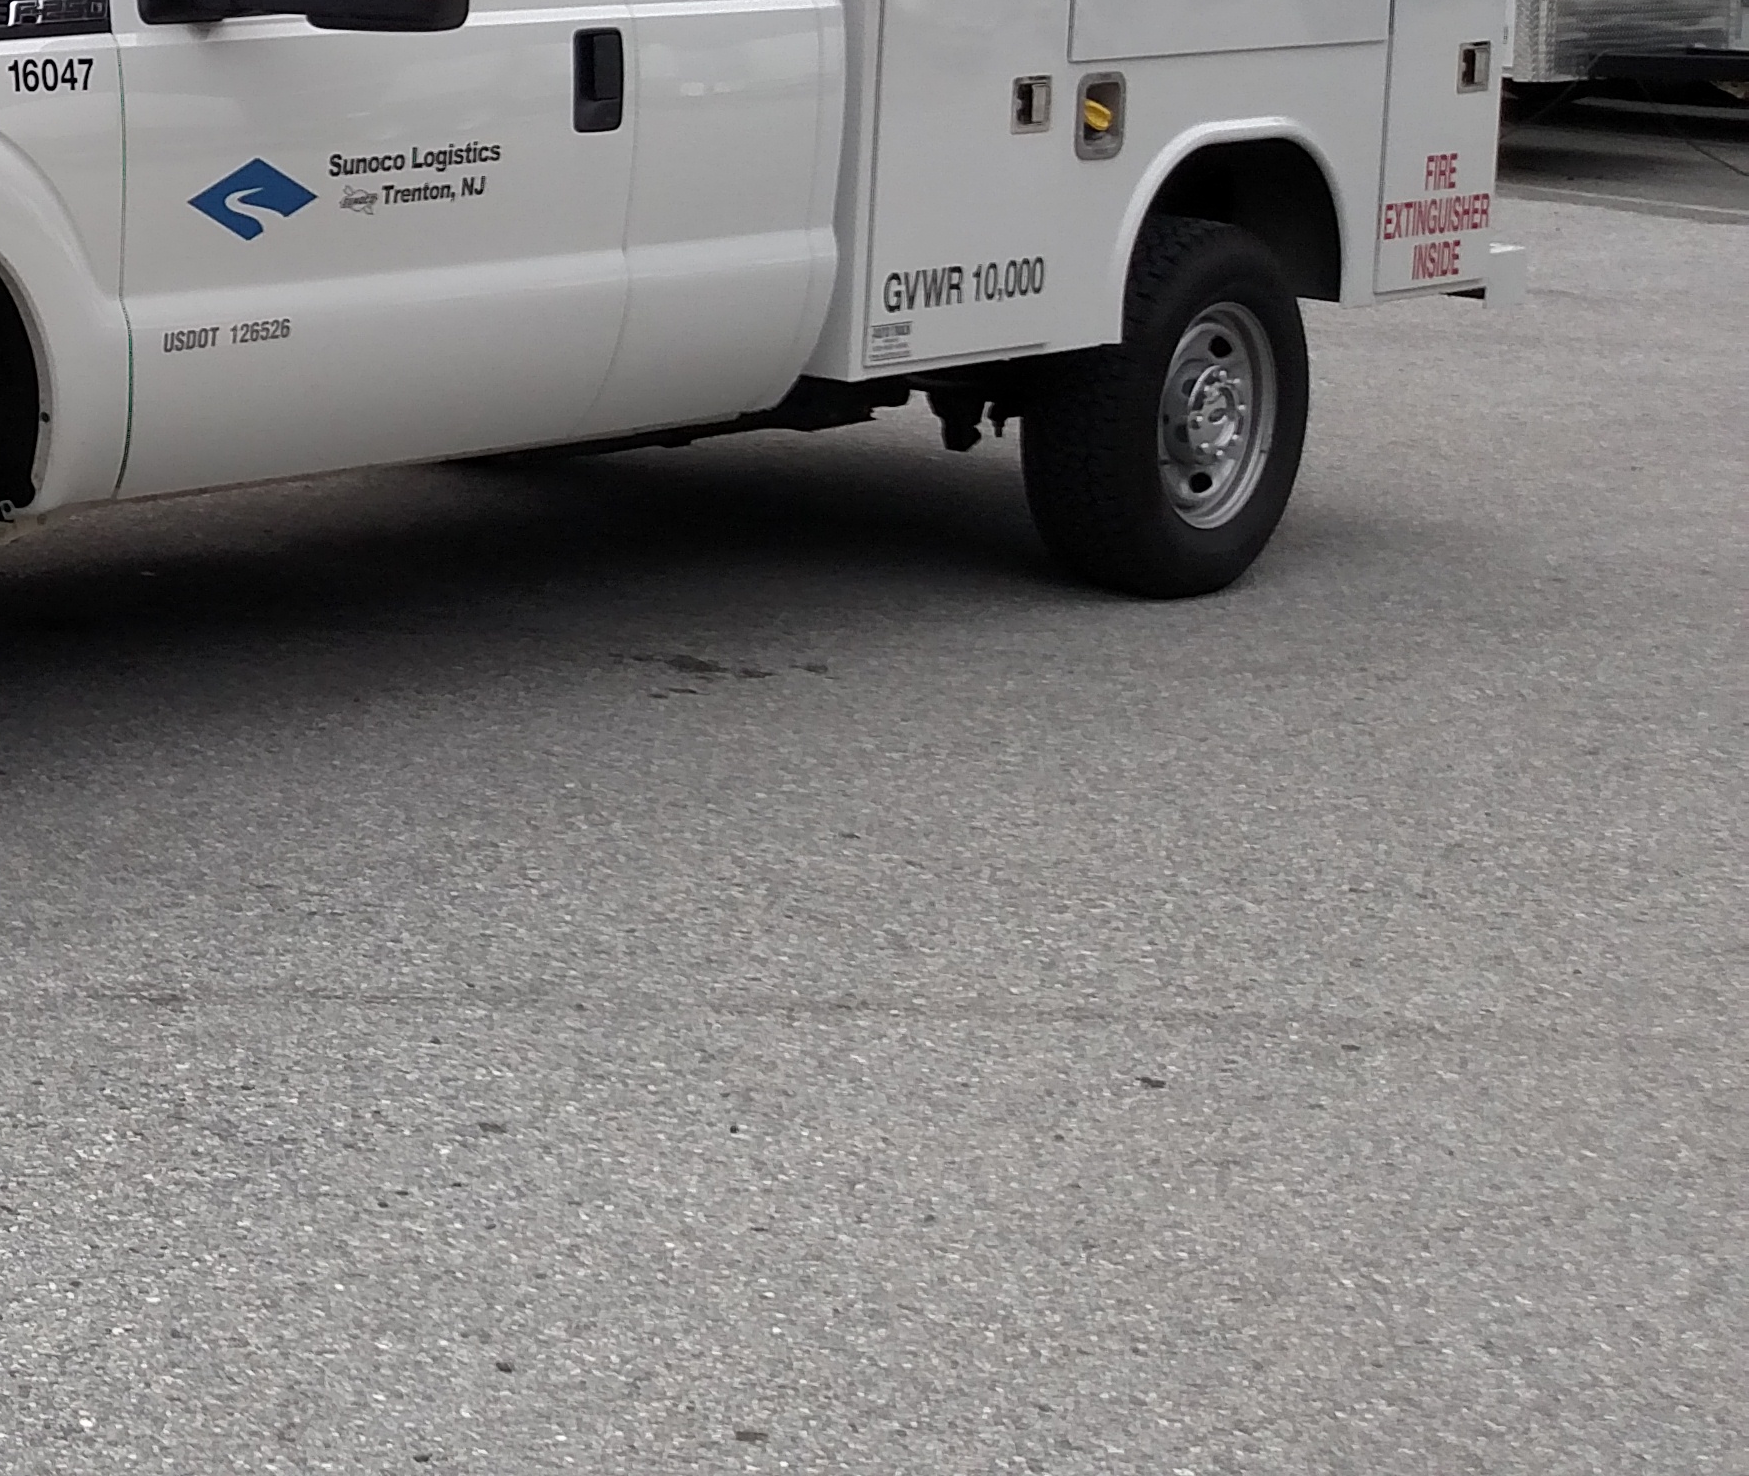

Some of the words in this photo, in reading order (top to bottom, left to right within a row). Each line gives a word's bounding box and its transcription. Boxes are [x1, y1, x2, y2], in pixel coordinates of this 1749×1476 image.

[7, 58, 94, 92] 16047
[329, 153, 405, 177] Sunoco
[411, 141, 501, 172] Logistics
[1425, 153, 1458, 191] FIRE
[382, 182, 456, 205] Trenton,
[461, 175, 486, 197] NJ
[1383, 193, 1490, 240] EXTINGUISHER
[1412, 239, 1461, 280] INSIDE
[883, 265, 964, 313] GVWR
[971, 256, 1045, 302] 10,000
[163, 327, 219, 353] USDOT
[230, 318, 291, 345] 126526
